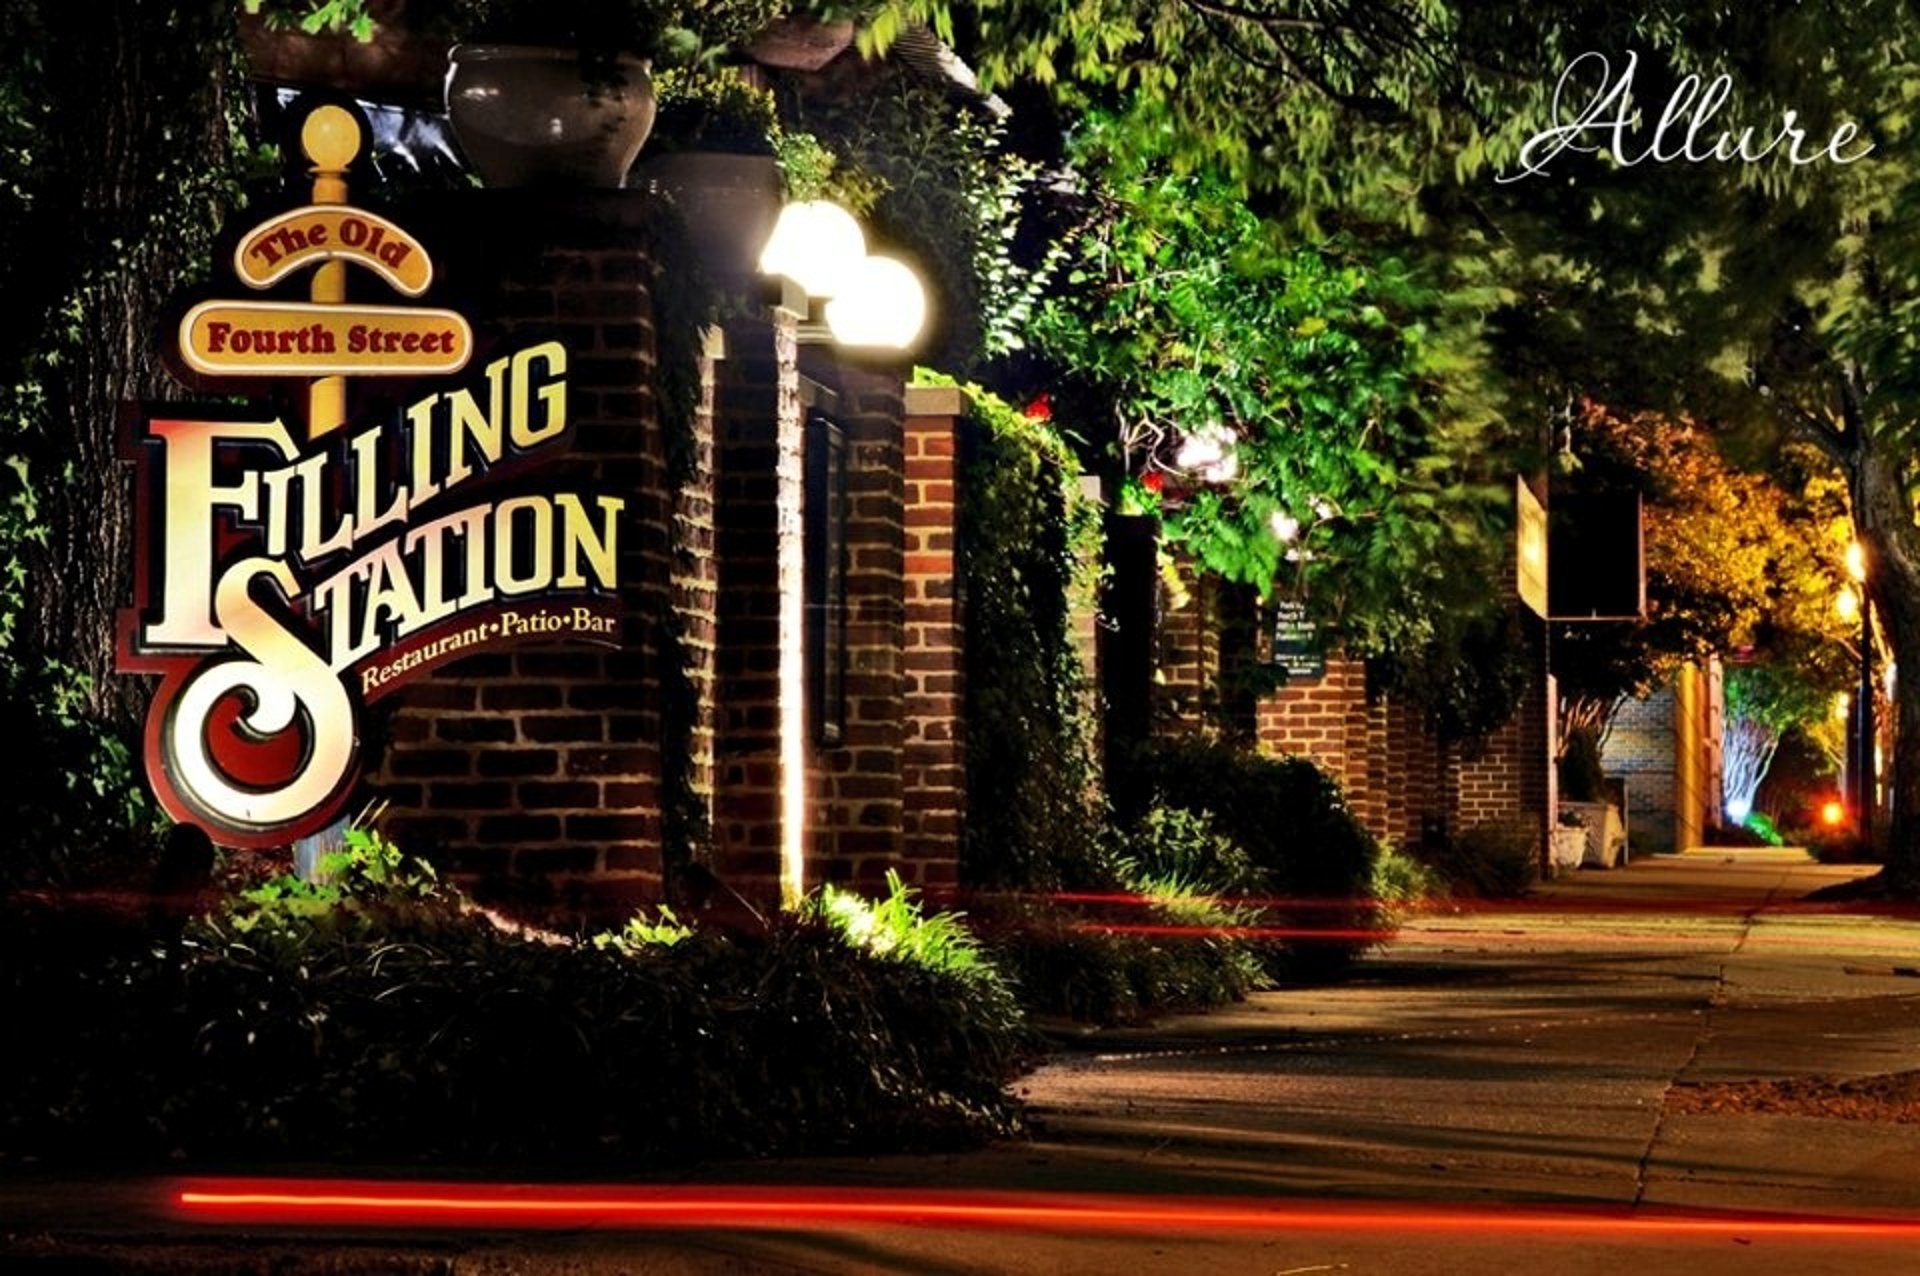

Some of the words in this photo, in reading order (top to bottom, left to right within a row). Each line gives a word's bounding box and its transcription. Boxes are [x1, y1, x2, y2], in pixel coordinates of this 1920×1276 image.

[252, 223, 328, 268] The
[338, 219, 413, 269] Old
[206, 322, 336, 354] Fourth
[347, 325, 455, 355] Street
[146, 340, 568, 646] FILLING
[173, 493, 626, 824] STATION
